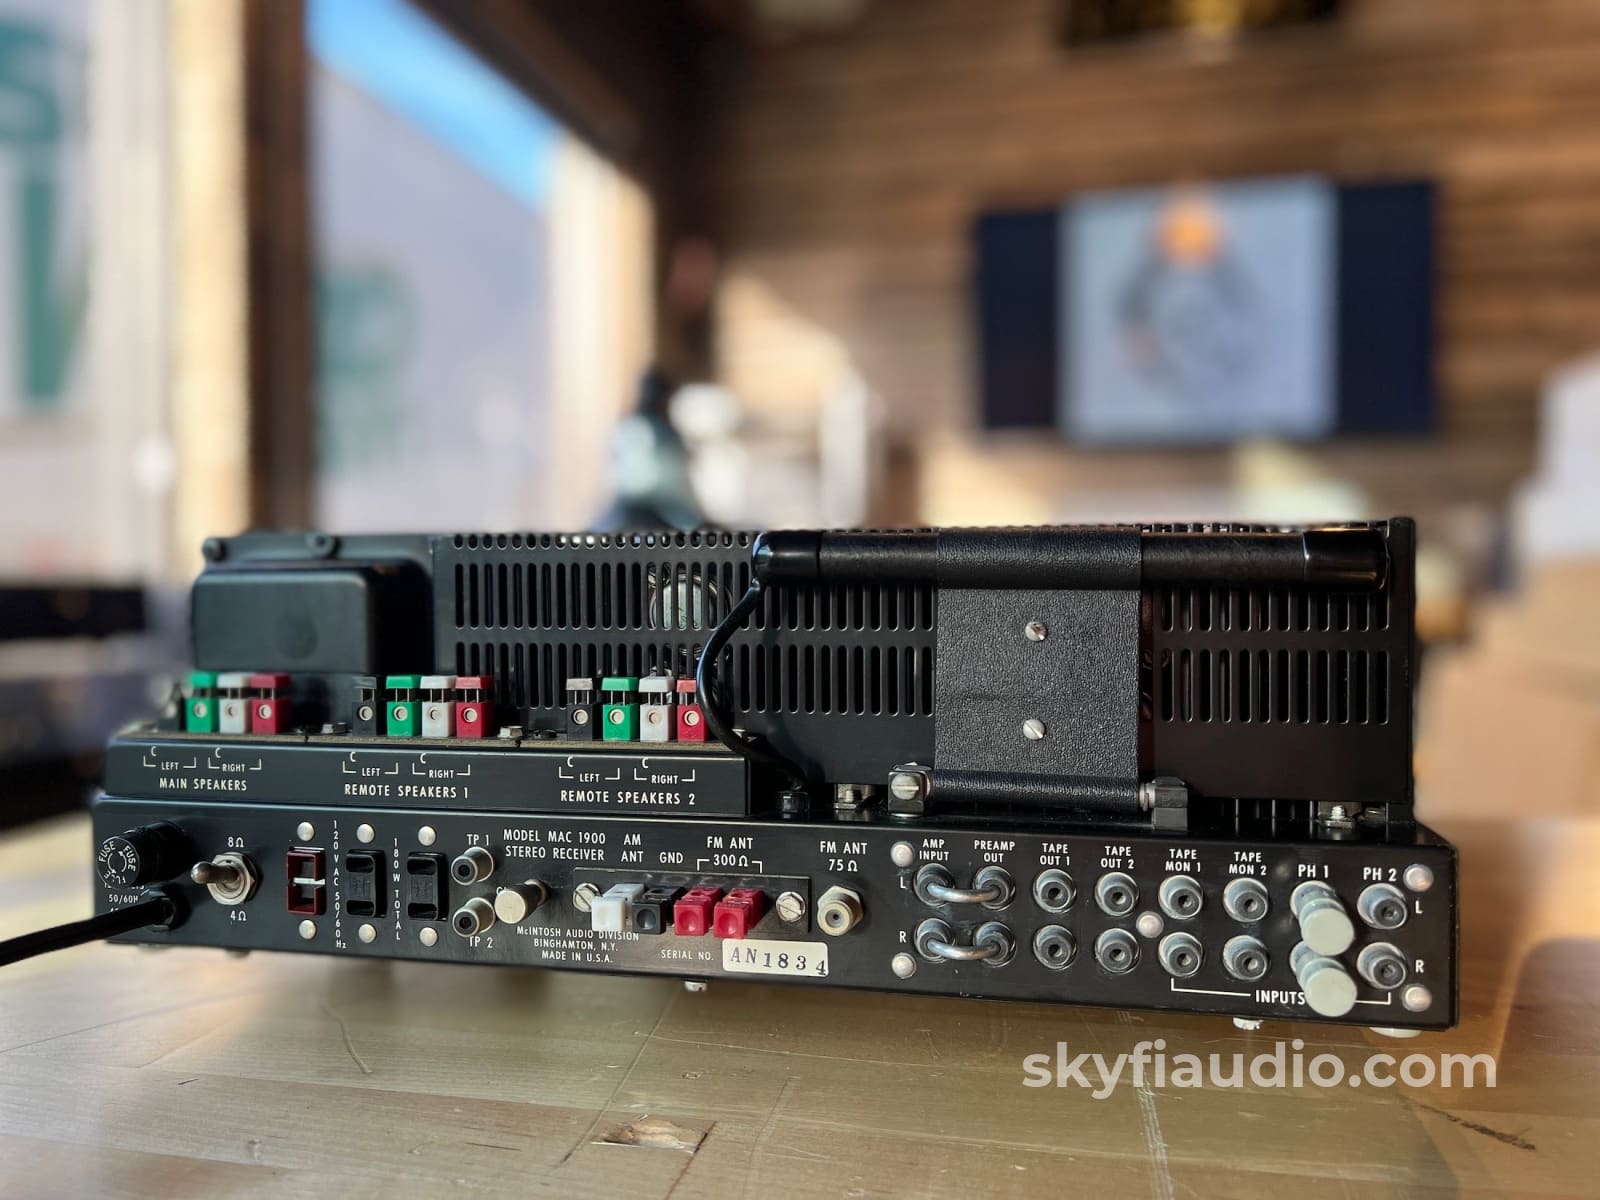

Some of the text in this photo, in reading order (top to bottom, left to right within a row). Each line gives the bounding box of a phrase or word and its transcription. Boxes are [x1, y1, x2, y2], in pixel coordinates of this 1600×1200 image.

[150, 746, 157, 757] C
[215, 747, 221, 759] C
[349, 751, 357, 763] C
[420, 752, 427, 764] C
[161, 761, 179, 771] LEFT
[222, 763, 245, 773] RIGHT
[566, 755, 574, 768] C
[641, 757, 649, 769] C
[361, 767, 381, 777] LEFT
[428, 769, 454, 779] RIGHT
[579, 773, 600, 783] LEFT
[159, 777, 247, 791] MAIN SPEAKERS
[651, 774, 679, 785] RIGHT
[344, 783, 390, 797] REMOTE
[397, 785, 457, 799] SPEAKERS
[560, 789, 695, 806] REMOTE SPEAKERS 2
[466, 833, 480, 846] TP
[503, 828, 606, 845] MODEL MAC 1900
[623, 833, 641, 846] AM
[706, 835, 754, 850] FM ANT
[820, 840, 868, 855] FM ANT
[922, 838, 945, 849] AMP
[974, 839, 1016, 851] PREAMP
[1041, 842, 1069, 854] TAPE
[98, 840, 117, 863] FUSE
[505, 845, 605, 861] STEREO RECEIVER
[620, 850, 644, 863] ANT
[659, 851, 684, 864] GND
[919, 850, 950, 861] INPUT
[983, 852, 1004, 863] OUT
[1104, 845, 1131, 857] TAPE
[1169, 848, 1197, 860] TAPE
[1233, 850, 1262, 863] TAPE
[122, 844, 137, 872] FUSE
[1039, 854, 1061, 866] OUT
[1100, 857, 1135, 870] OUT 2
[1165, 860, 1191, 872] MON
[1228, 863, 1267, 876] MON 2
[1298, 863, 1316, 878] PH
[1363, 866, 1397, 882] PH 2
[900, 876, 907, 889] L
[1415, 900, 1423, 914] L
[516, 925, 640, 942] McINTOSH AUDIO DIVISION
[899, 930, 907, 943] R
[467, 934, 493, 949] TP 2
[533, 938, 619, 952] BINGHAMTON, N.Y.
[541, 949, 614, 963] MADE IN U.S.A.
[661, 949, 714, 961] SERIAL NO.
[1415, 959, 1425, 973] R
[1254, 989, 1305, 1006] INPUTS
